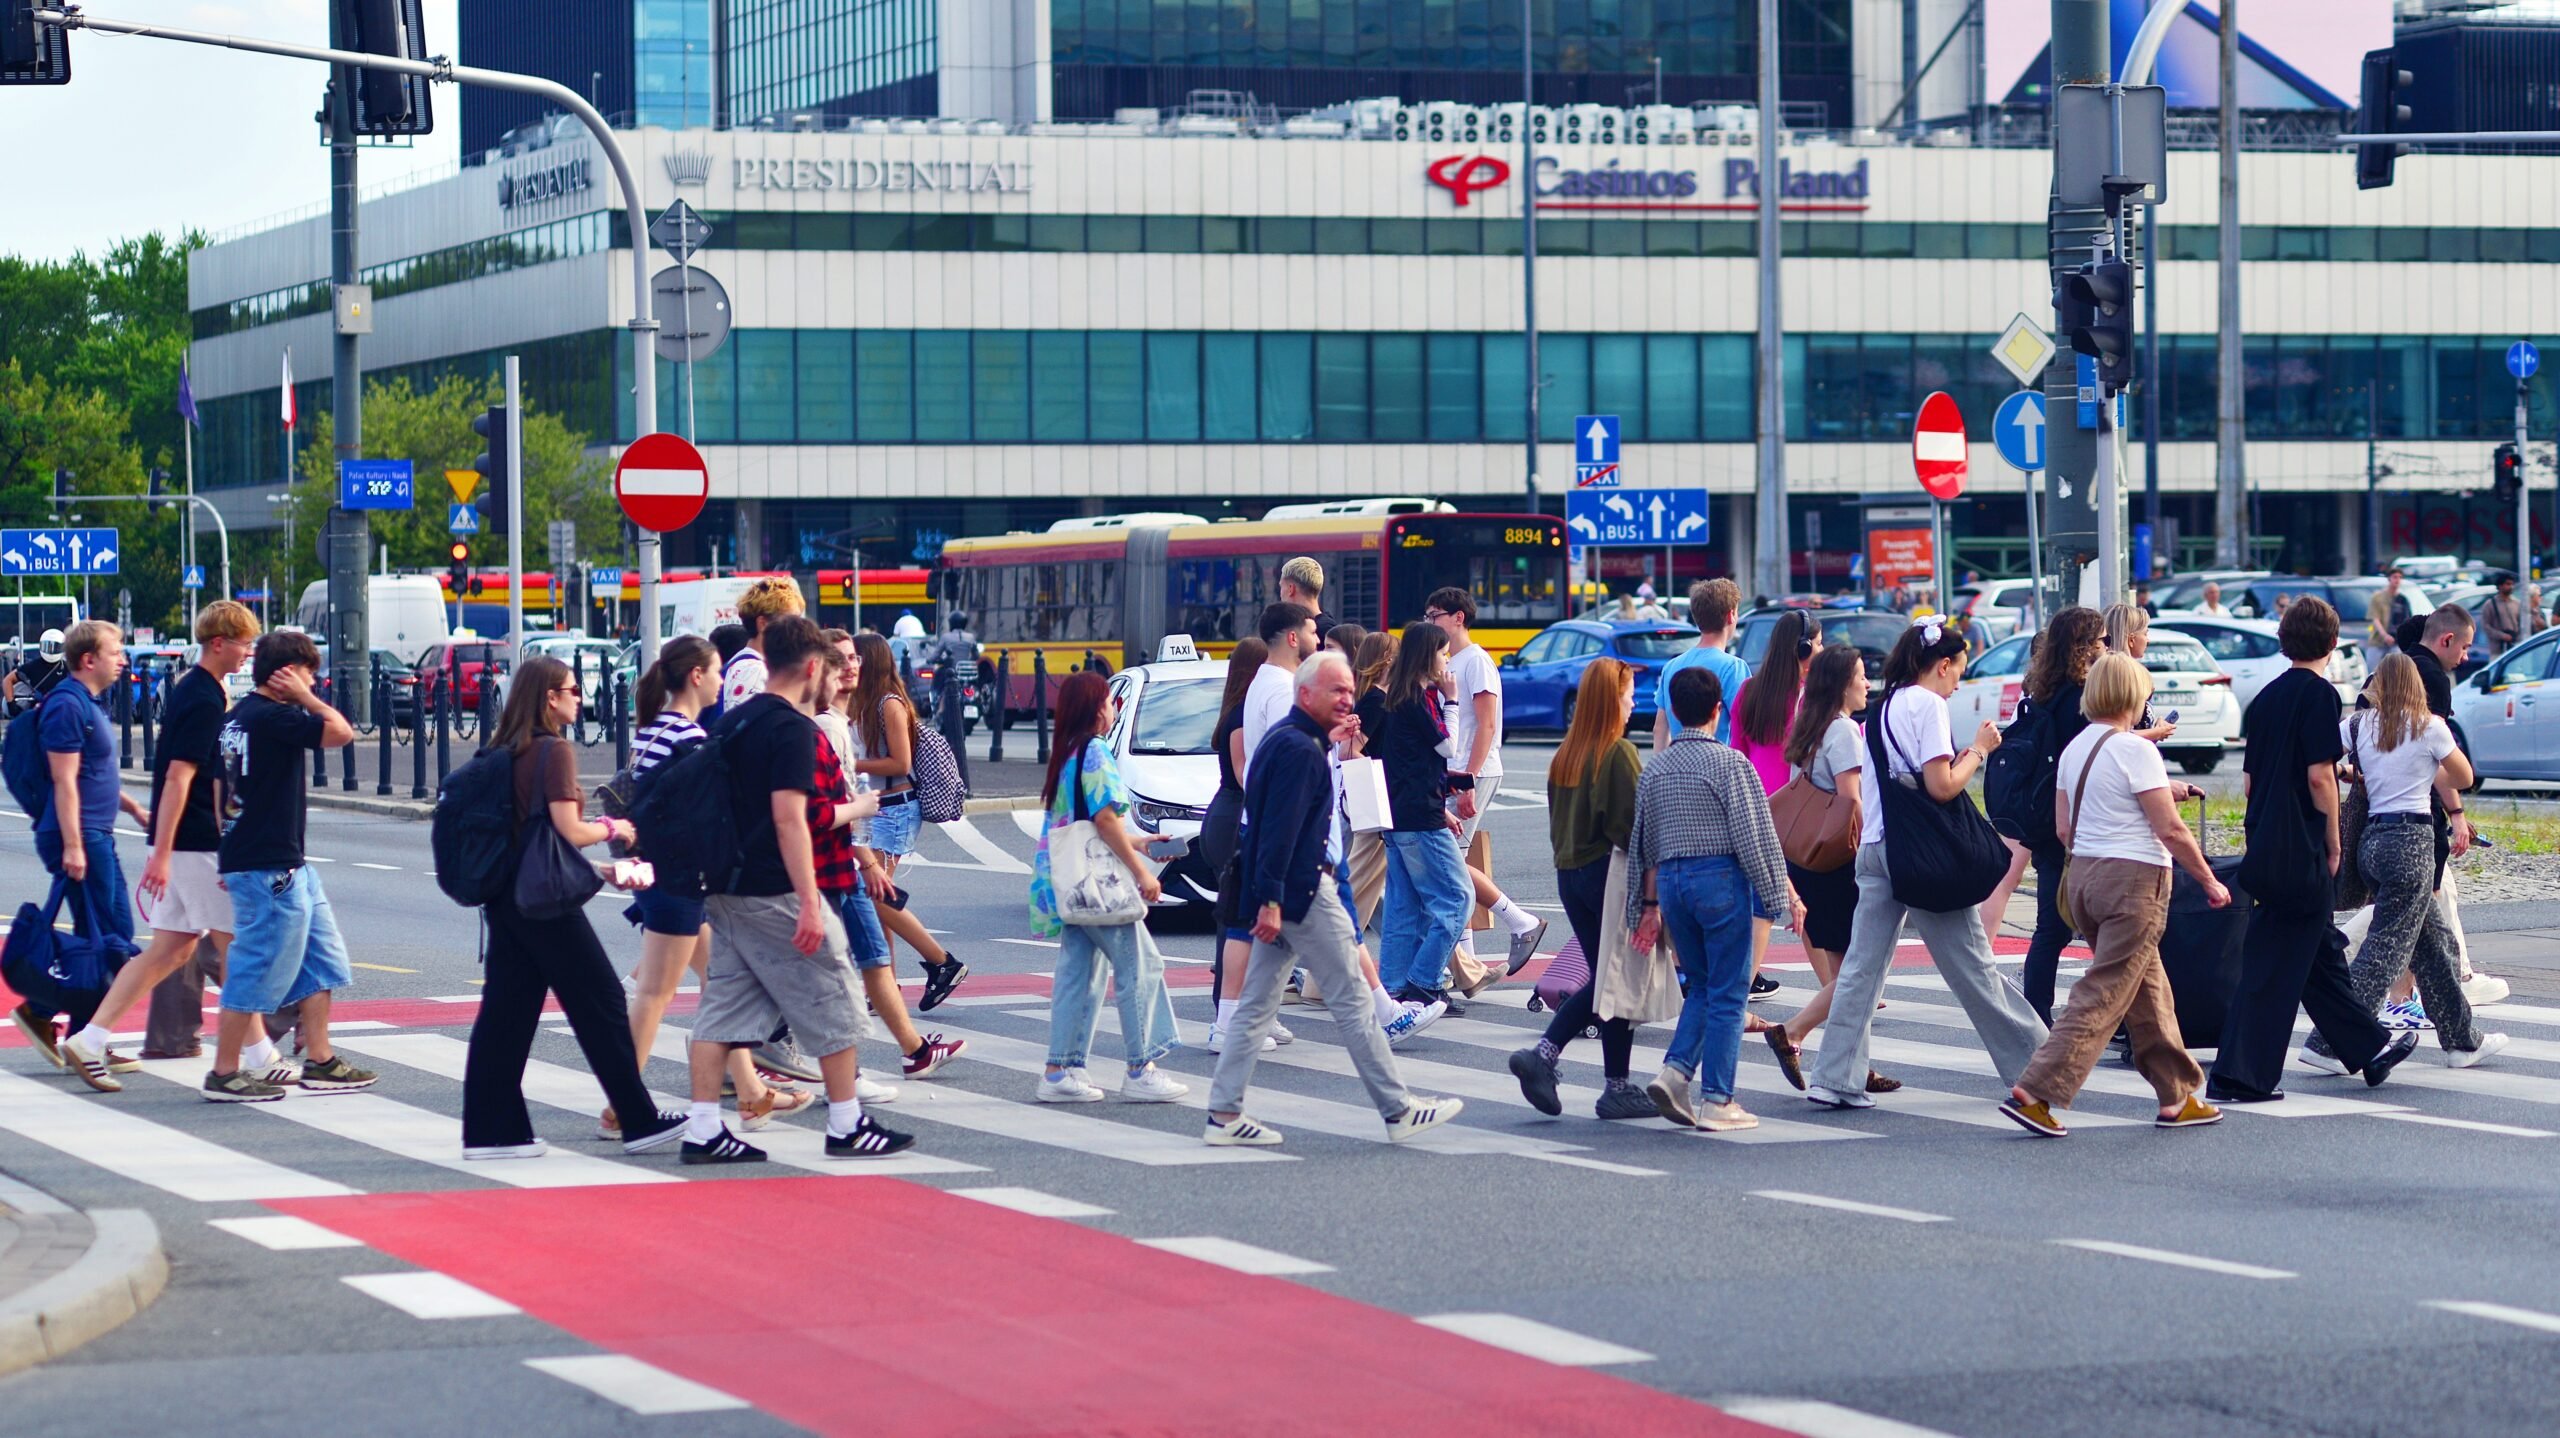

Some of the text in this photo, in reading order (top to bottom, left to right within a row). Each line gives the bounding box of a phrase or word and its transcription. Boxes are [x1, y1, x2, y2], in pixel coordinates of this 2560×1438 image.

[513, 158, 588, 206] PRESIDENTIAL
[735, 157, 1031, 193] PRESIDENTIAL
[1533, 157, 1869, 199] Casinos Pland
[1577, 467, 1619, 485] TAXI
[352, 483, 360, 495] P
[1504, 527, 1543, 544] 8894
[1606, 524, 1637, 539] BUS
[34, 557, 60, 570] BUS
[593, 570, 620, 582] TAXI
[1170, 645, 1191, 656] TAXI
